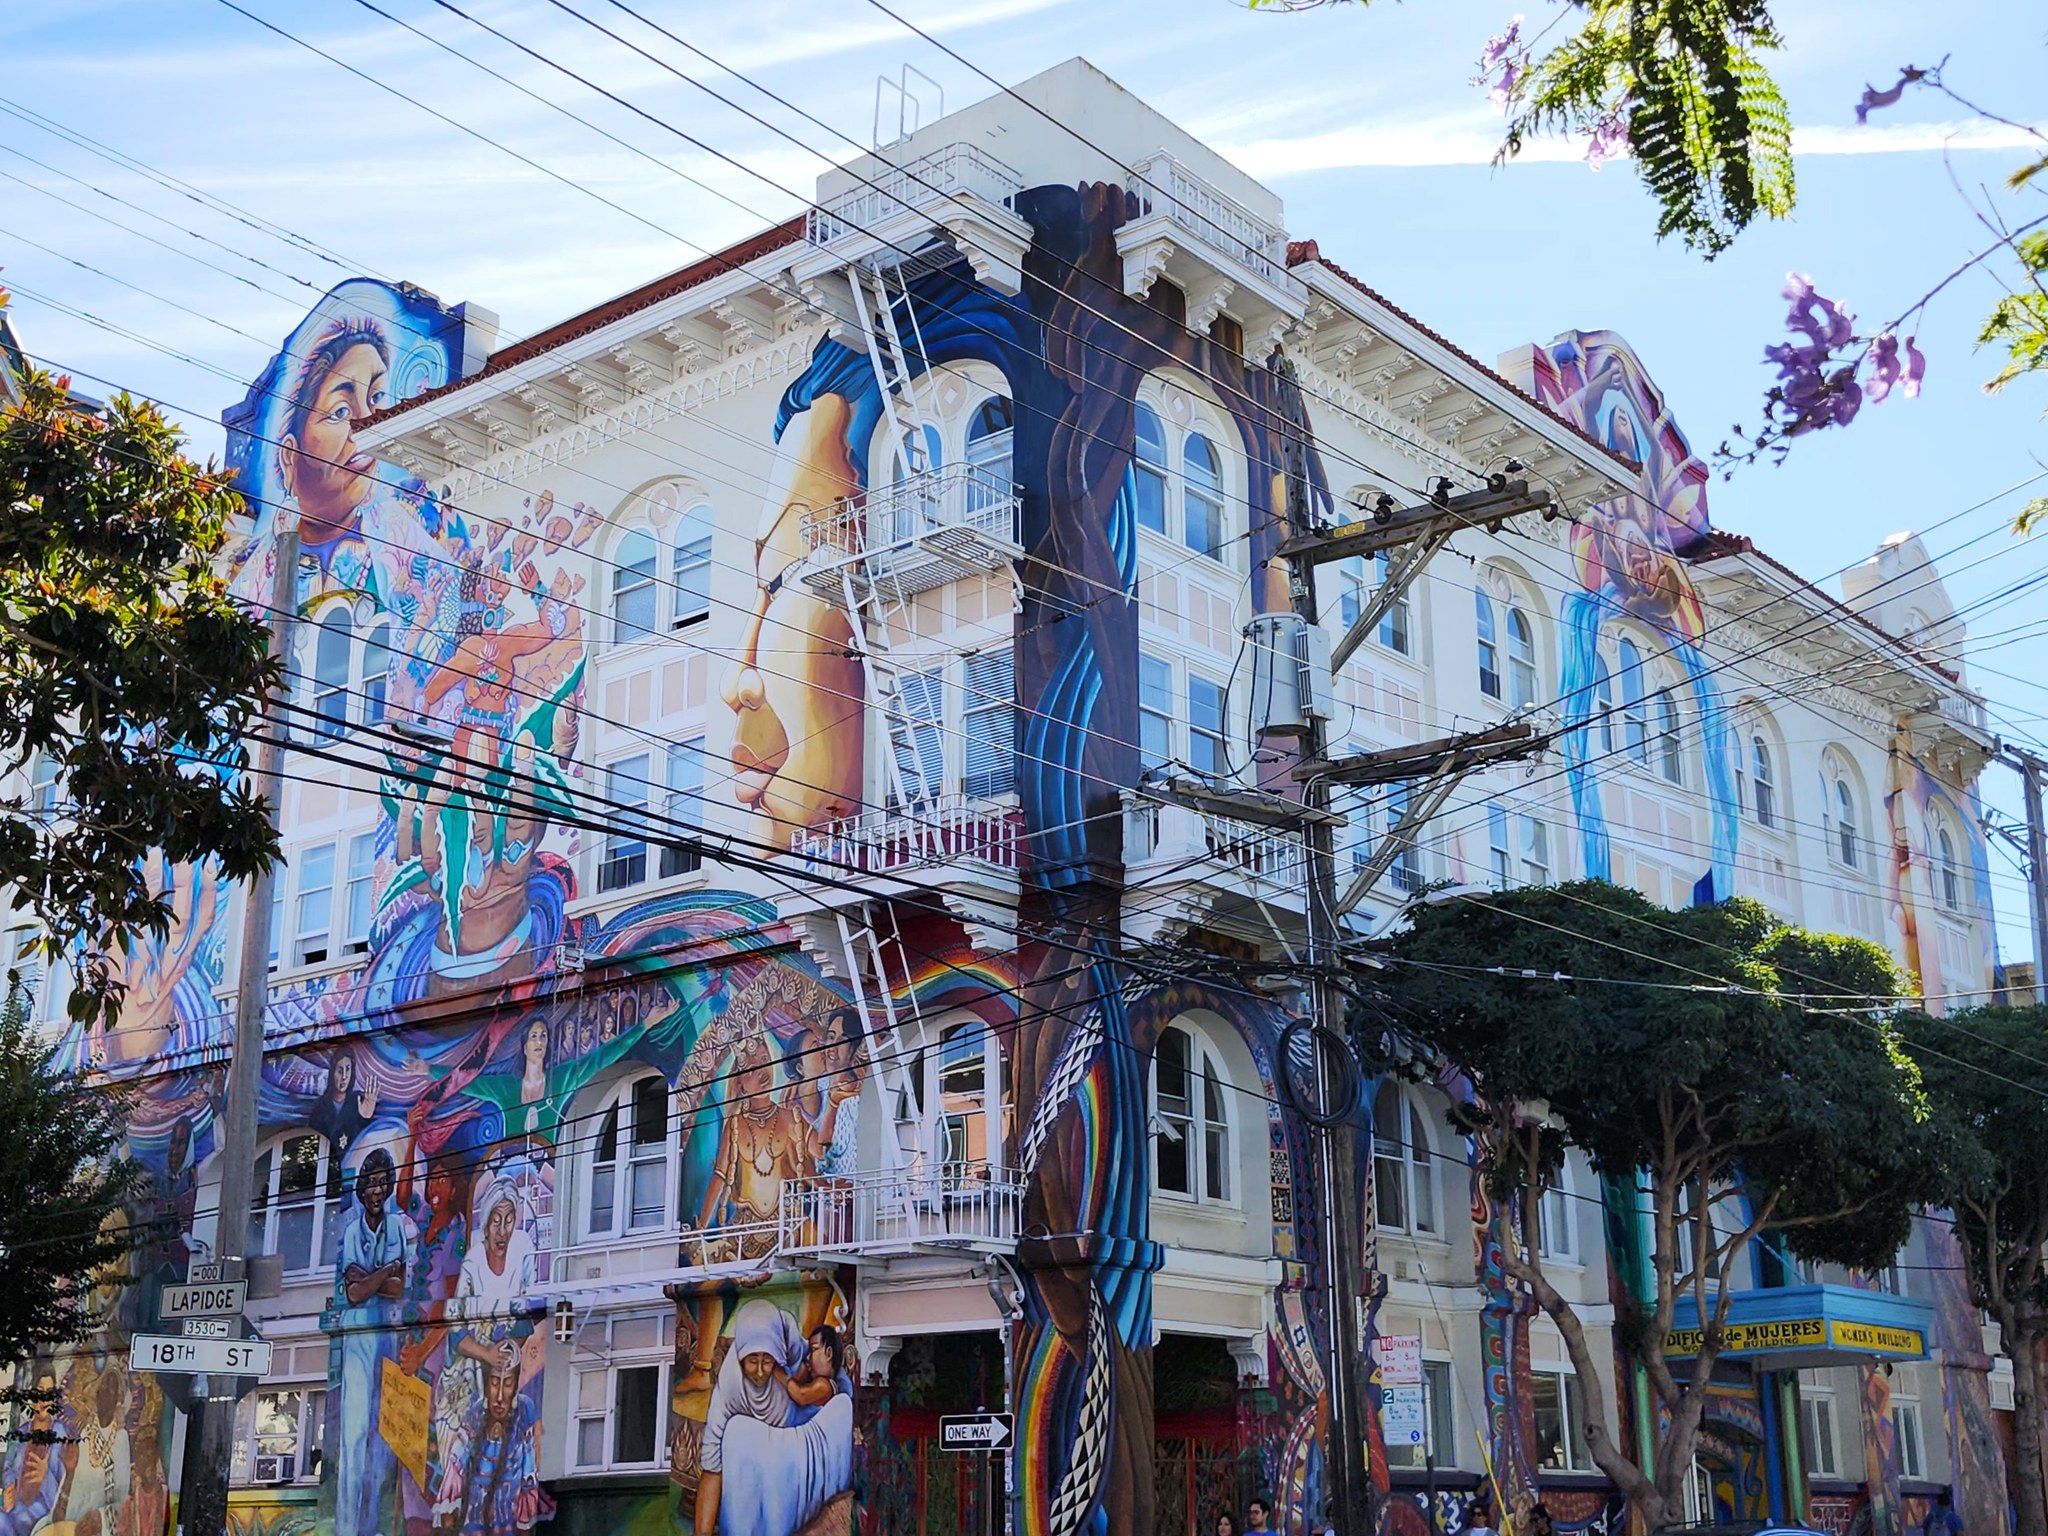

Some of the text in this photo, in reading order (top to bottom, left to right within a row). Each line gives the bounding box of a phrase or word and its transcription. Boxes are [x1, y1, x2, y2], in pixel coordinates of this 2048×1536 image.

[201, 1267, 218, 1280] 000
[171, 1289, 235, 1312] LAPIDGE
[187, 1322, 216, 1335] 3530
[1725, 1328, 1742, 1341] de
[1746, 1321, 1821, 1340] MUJERES
[1381, 1337, 1393, 1350] NO
[1743, 1337, 1799, 1348] BUILDING
[1840, 1327, 1912, 1348] WOMEN'S BUILDING
[151, 1343, 253, 1368] 18TH ST
[1383, 1389, 1393, 1403] 2
[948, 1426, 991, 1439] ONE WAY
